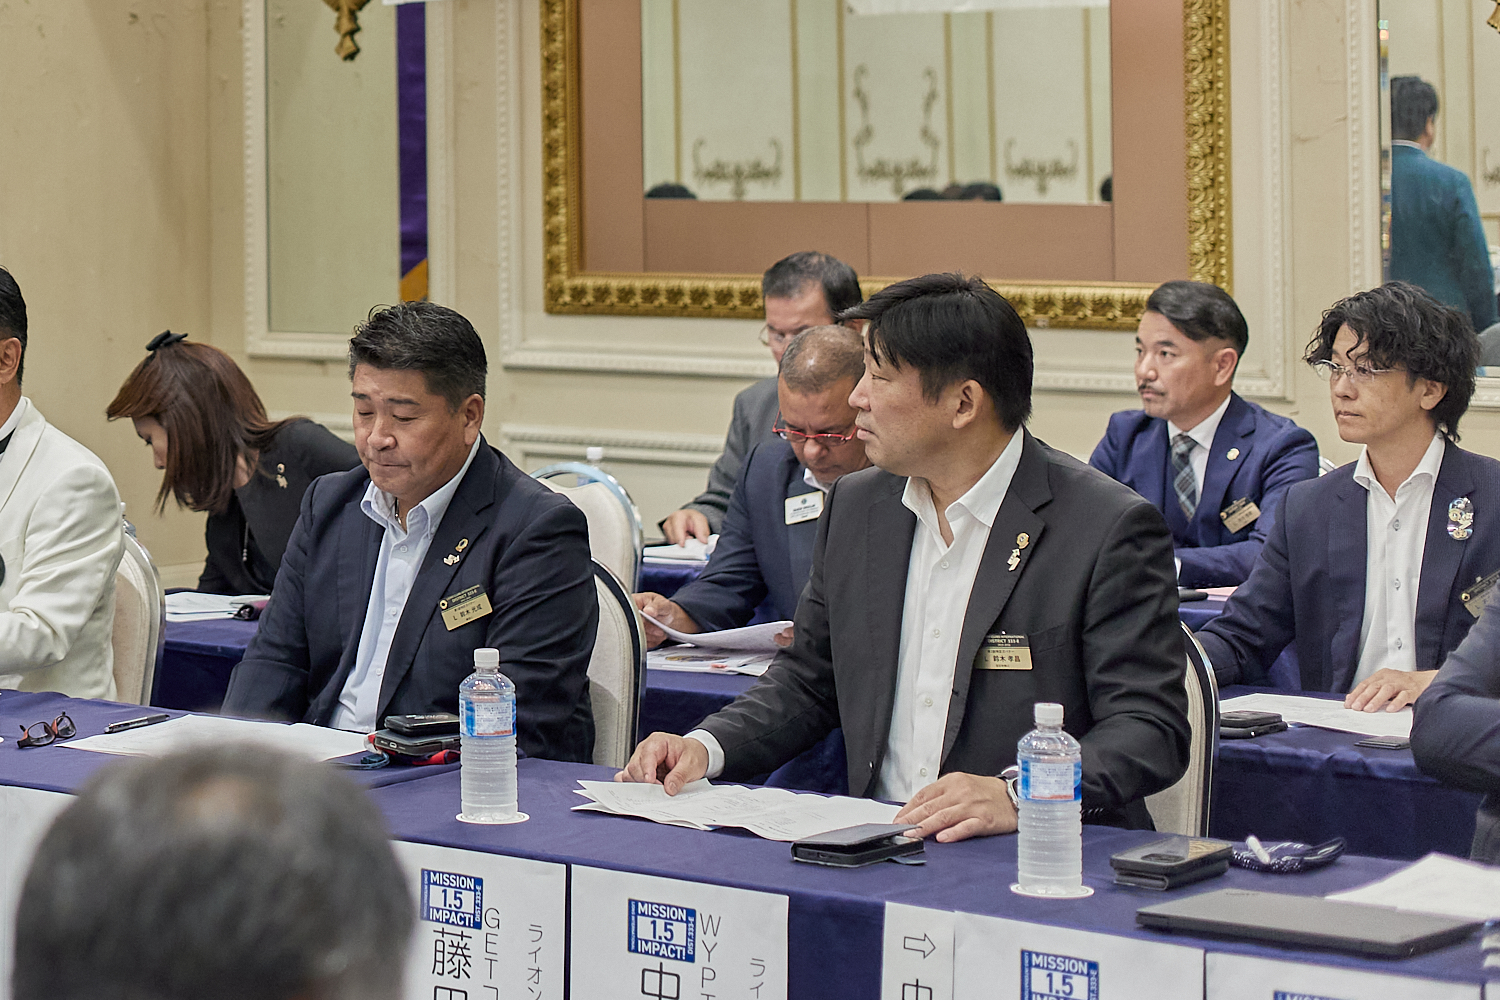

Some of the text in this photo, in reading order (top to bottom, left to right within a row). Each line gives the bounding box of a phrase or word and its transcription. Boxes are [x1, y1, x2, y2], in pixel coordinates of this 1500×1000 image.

[430, 871, 475, 890] MISSION
[441, 888, 463, 910] 1.5
[429, 907, 474, 928] IMPACT!
[637, 901, 687, 922] MISSION
[650, 919, 674, 942] 1.5
[687, 916, 695, 955] DIST.333-E
[637, 939, 686, 960] IMPACT!
[1031, 953, 1088, 975] MISSION
[1046, 972, 1074, 996] 1.5
